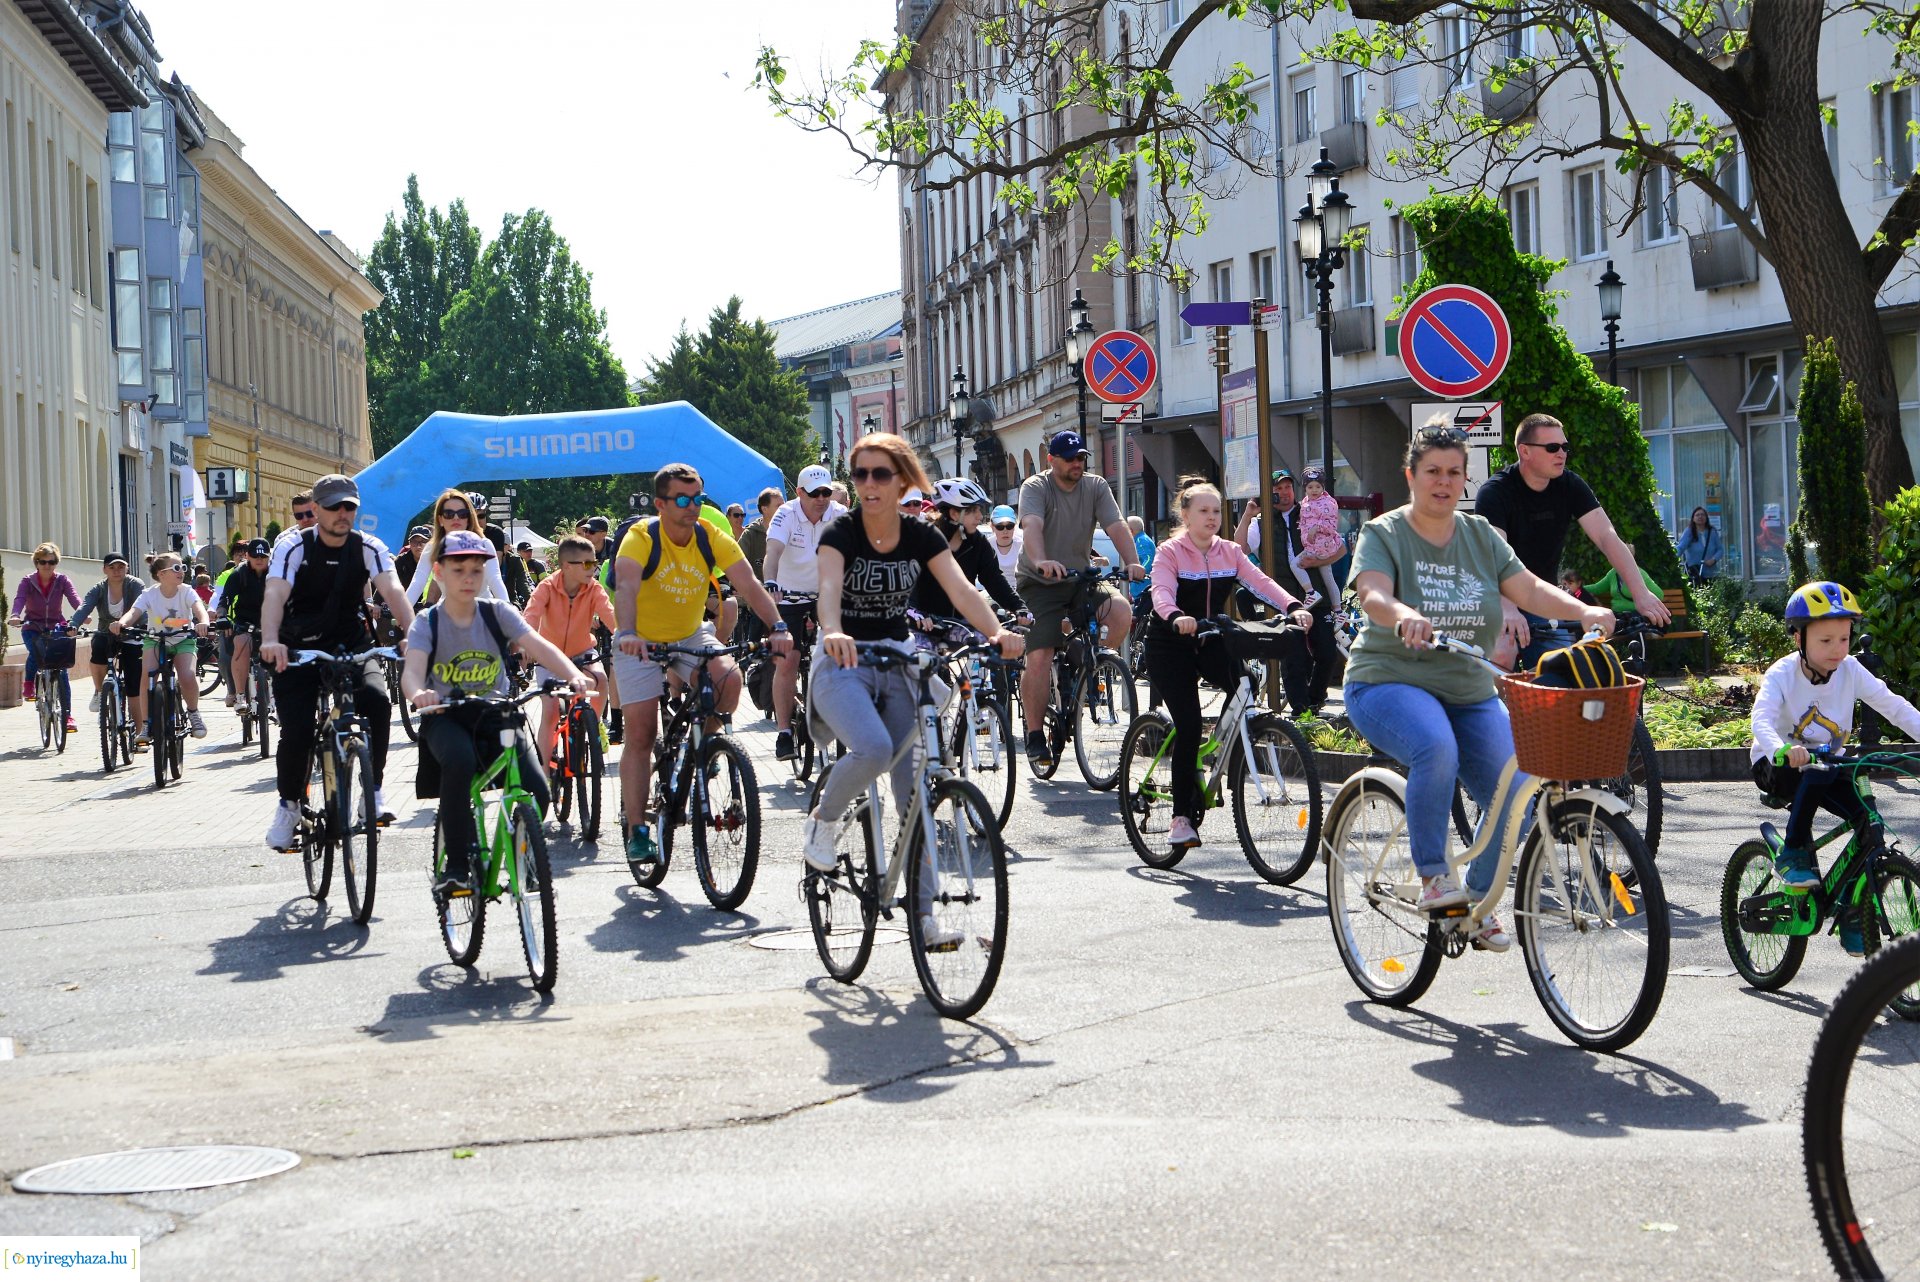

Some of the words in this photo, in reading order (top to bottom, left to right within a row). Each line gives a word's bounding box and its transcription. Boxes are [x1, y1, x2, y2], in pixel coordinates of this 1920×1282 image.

[484, 429, 635, 458] SHIMANO
[843, 556, 922, 593] RETRO
[1415, 560, 1457, 576] NATURE
[1420, 587, 1450, 600] WITH
[1422, 600, 1446, 612] THE
[1448, 600, 1482, 612] MOST
[432, 656, 501, 685] Vintag
